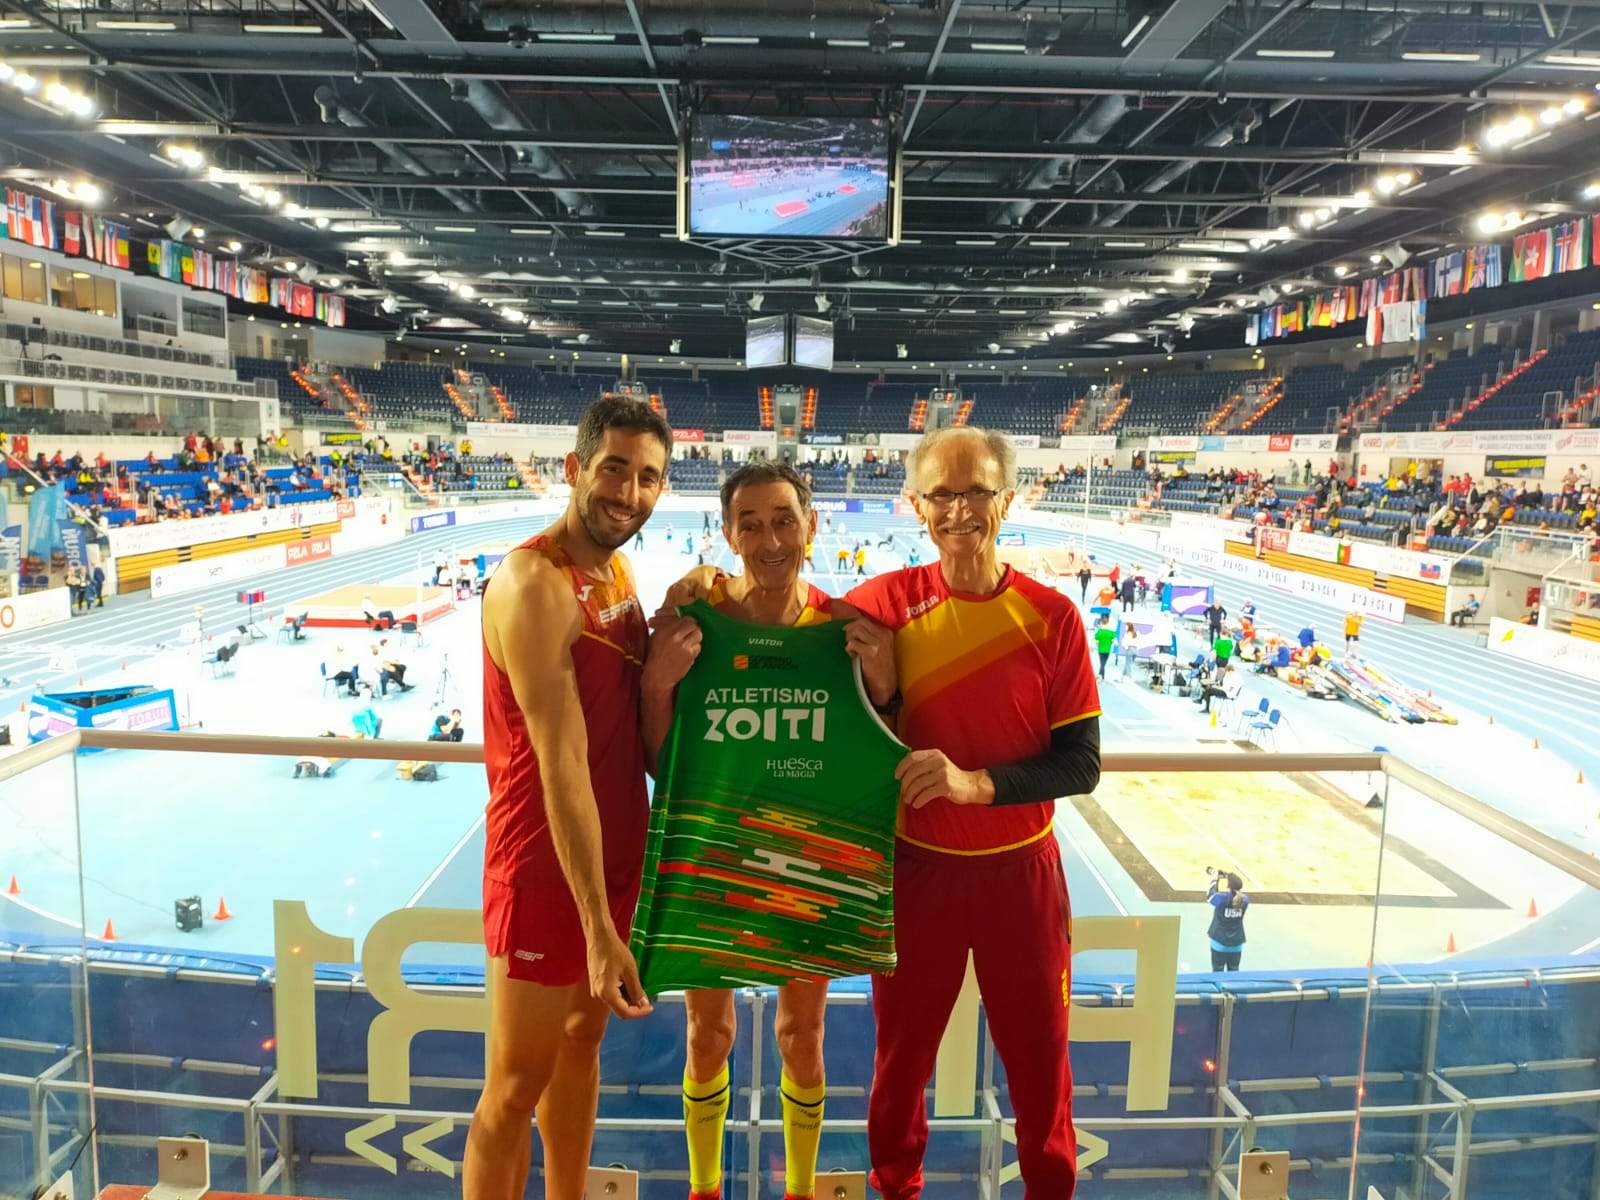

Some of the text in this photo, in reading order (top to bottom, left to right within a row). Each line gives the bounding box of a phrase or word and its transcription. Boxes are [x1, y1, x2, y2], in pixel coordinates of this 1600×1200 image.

[748, 637, 784, 647] VIATOR
[704, 687, 829, 705] ATLETISMO
[703, 707, 826, 743] ZOITI
